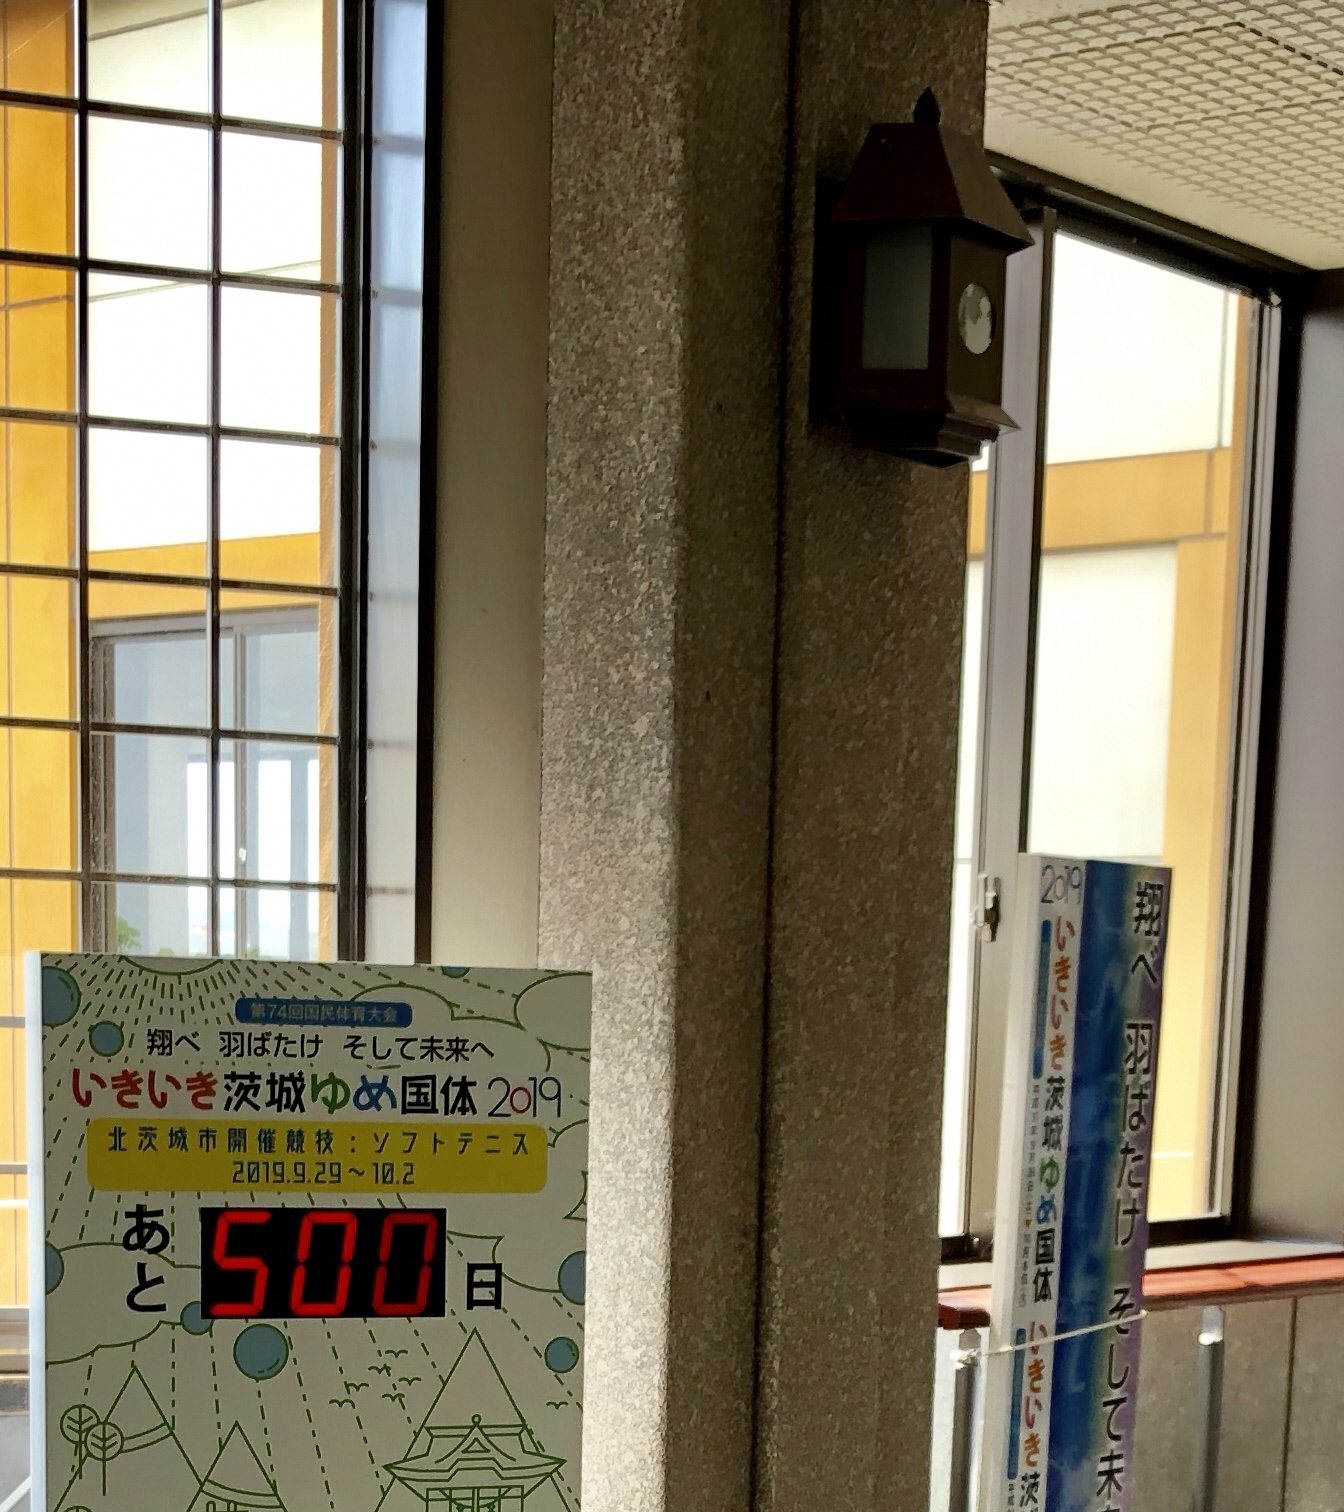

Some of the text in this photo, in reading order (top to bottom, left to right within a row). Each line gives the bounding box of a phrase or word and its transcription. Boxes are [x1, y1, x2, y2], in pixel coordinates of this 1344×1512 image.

[1041, 864, 1083, 904] 2019
[72, 1067, 562, 1118] いきいき茨城ゆめ国体 2019
[1033, 915, 1076, 1304] いきいき茨城ゆめ国体
[122, 1203, 170, 1313] あと
[209, 1211, 440, 1317] 500
[466, 1262, 503, 1310] 日
